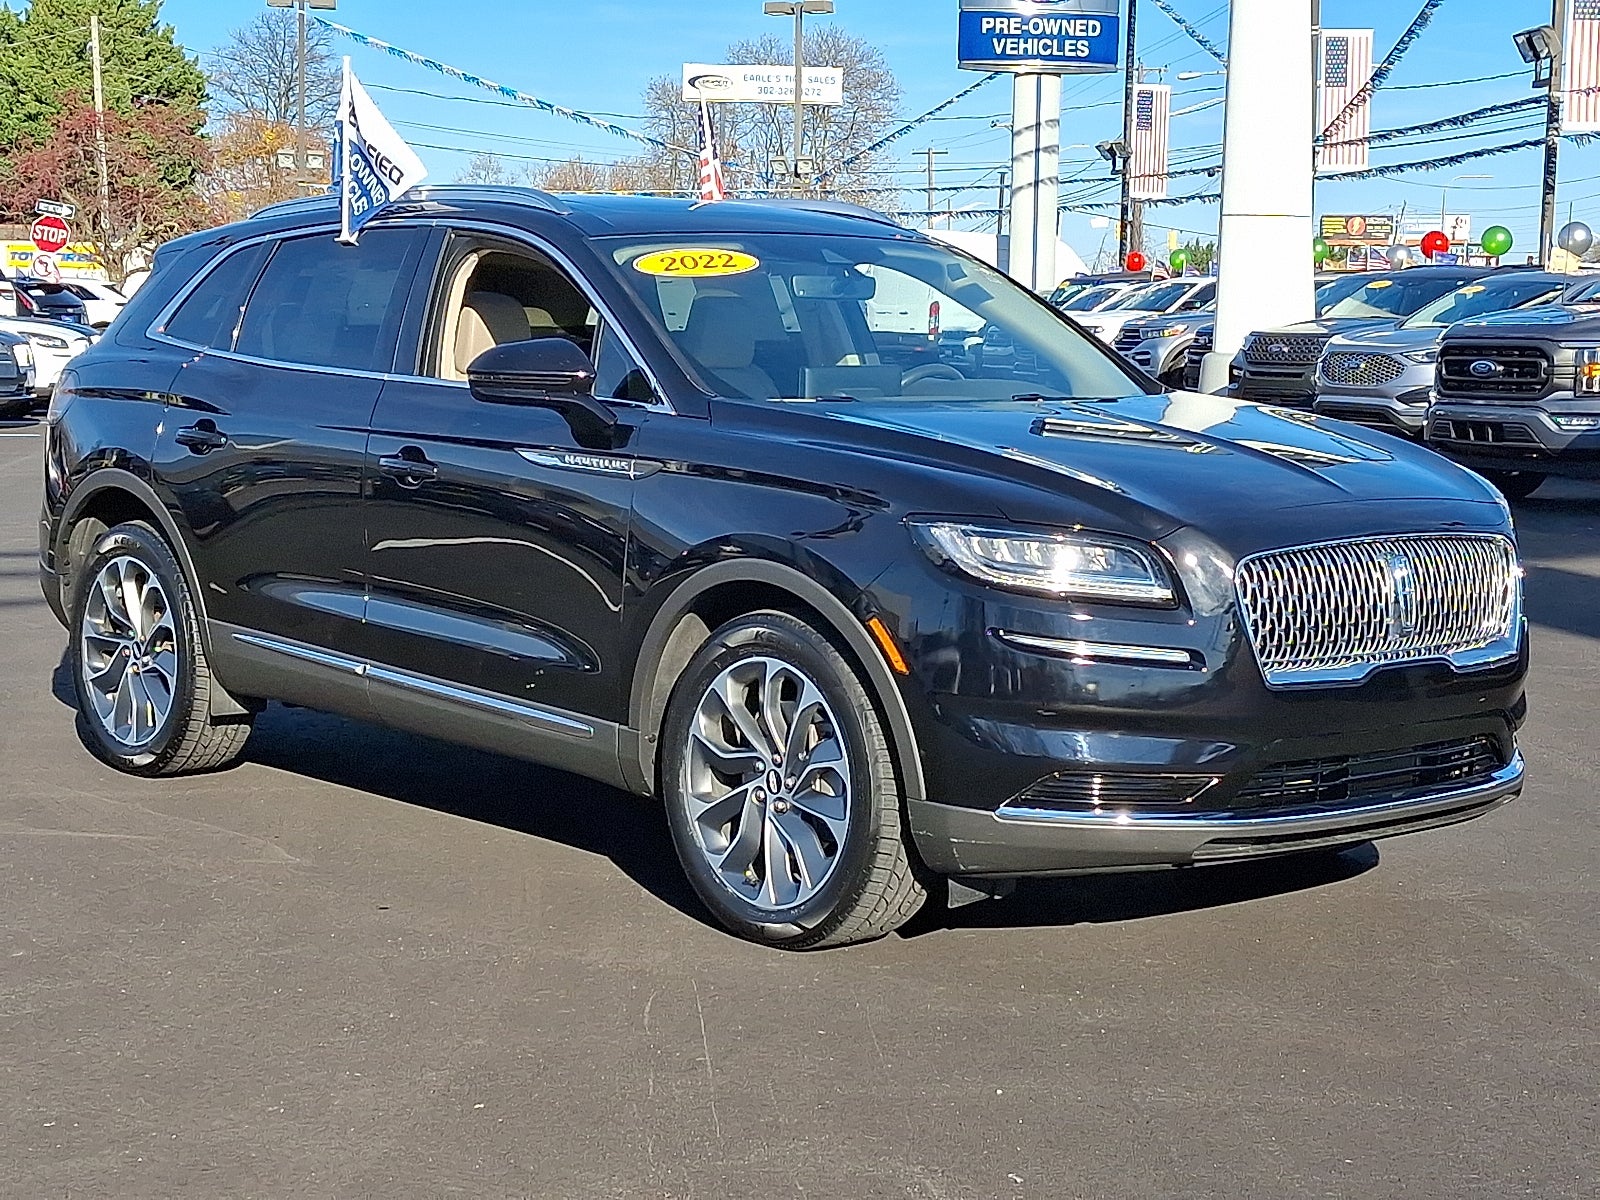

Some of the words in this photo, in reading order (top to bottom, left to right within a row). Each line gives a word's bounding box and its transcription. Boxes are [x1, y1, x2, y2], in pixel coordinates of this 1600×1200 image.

[981, 17, 1101, 37] PRE-OWNED
[992, 38, 1090, 57] VEHICLES
[743, 74, 781, 83] EARLE'S
[807, 76, 836, 85] SALES
[33, 225, 68, 244] STOP
[660, 254, 738, 271] 2022
[564, 454, 629, 470] NAUTILUS
